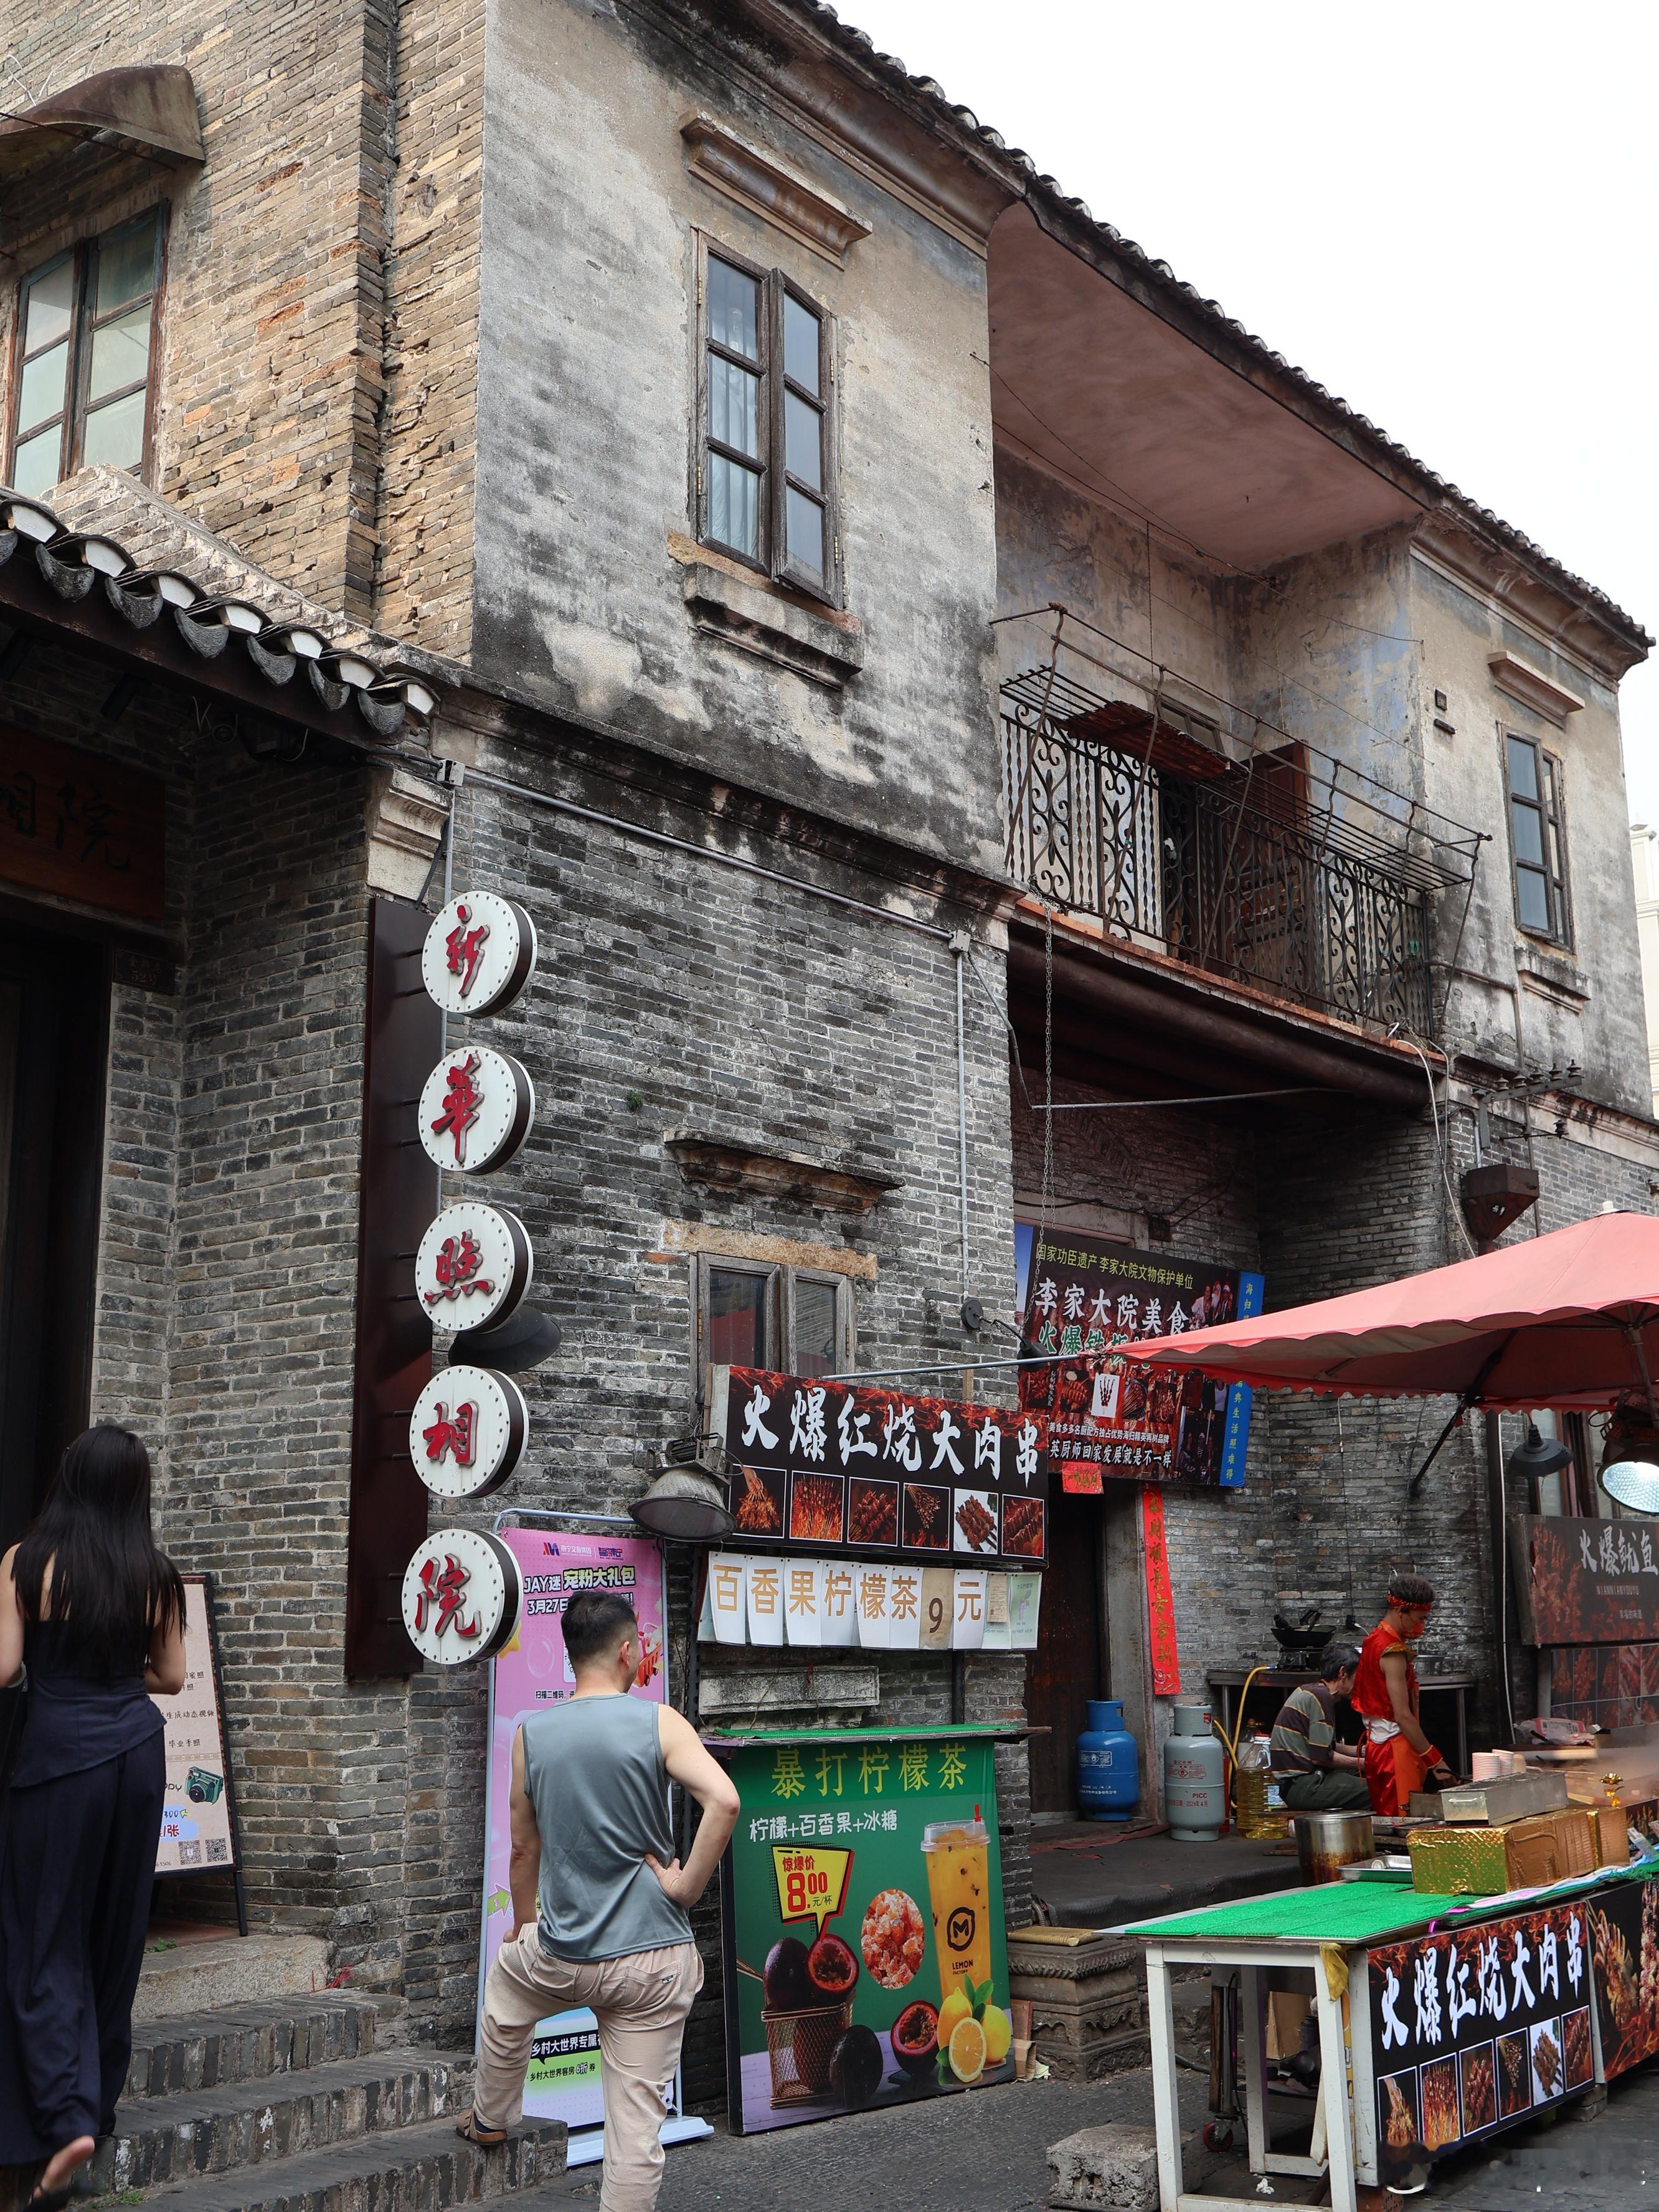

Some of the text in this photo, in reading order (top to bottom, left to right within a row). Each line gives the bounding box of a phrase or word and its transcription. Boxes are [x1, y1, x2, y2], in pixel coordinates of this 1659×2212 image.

[1034, 1277, 1189, 1335] 李家大院美食
[740, 1384, 1039, 1490] 火爆红烧大肉串
[1047, 1422, 1170, 1444] 美食多多名厨配方独占优势海归精英再树品牌
[1048, 1439, 1172, 1468] 英厨师回家发展就是不一样
[1579, 1525, 1659, 1577] 火爆鱿鱼
[563, 1566, 635, 1590] 宠粉大礼包
[771, 1744, 967, 1798] 暴打柠檬茶
[749, 1809, 897, 1842] 柠檬+百香果+冰糖
[782, 1855, 815, 1872] 惊爆价
[812, 1894, 833, 1908] 元/杯
[952, 1959, 973, 1970] LEMON
[1381, 1910, 1583, 2050] 火爆红烧大肉串
